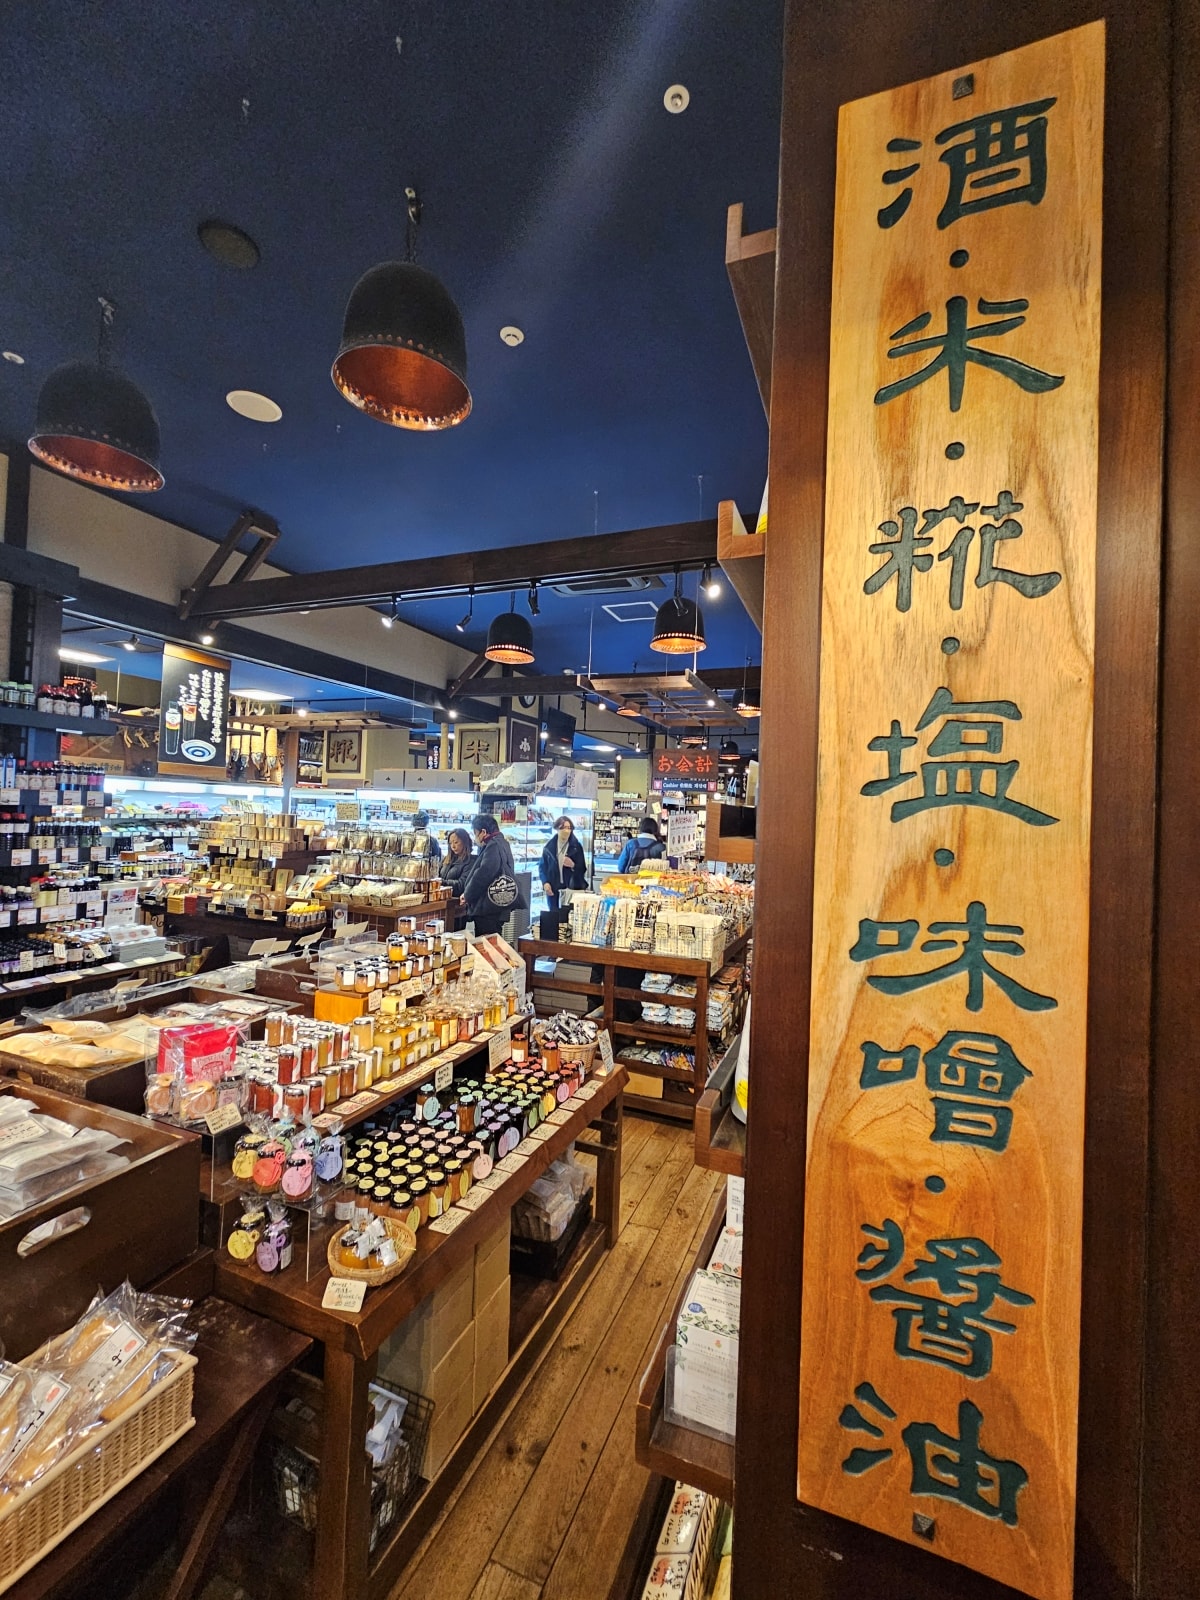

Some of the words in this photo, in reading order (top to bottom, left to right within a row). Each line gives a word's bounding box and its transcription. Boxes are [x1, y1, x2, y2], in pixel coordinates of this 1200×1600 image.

[463, 739, 494, 765] 米
[658, 754, 713, 773] お会計
